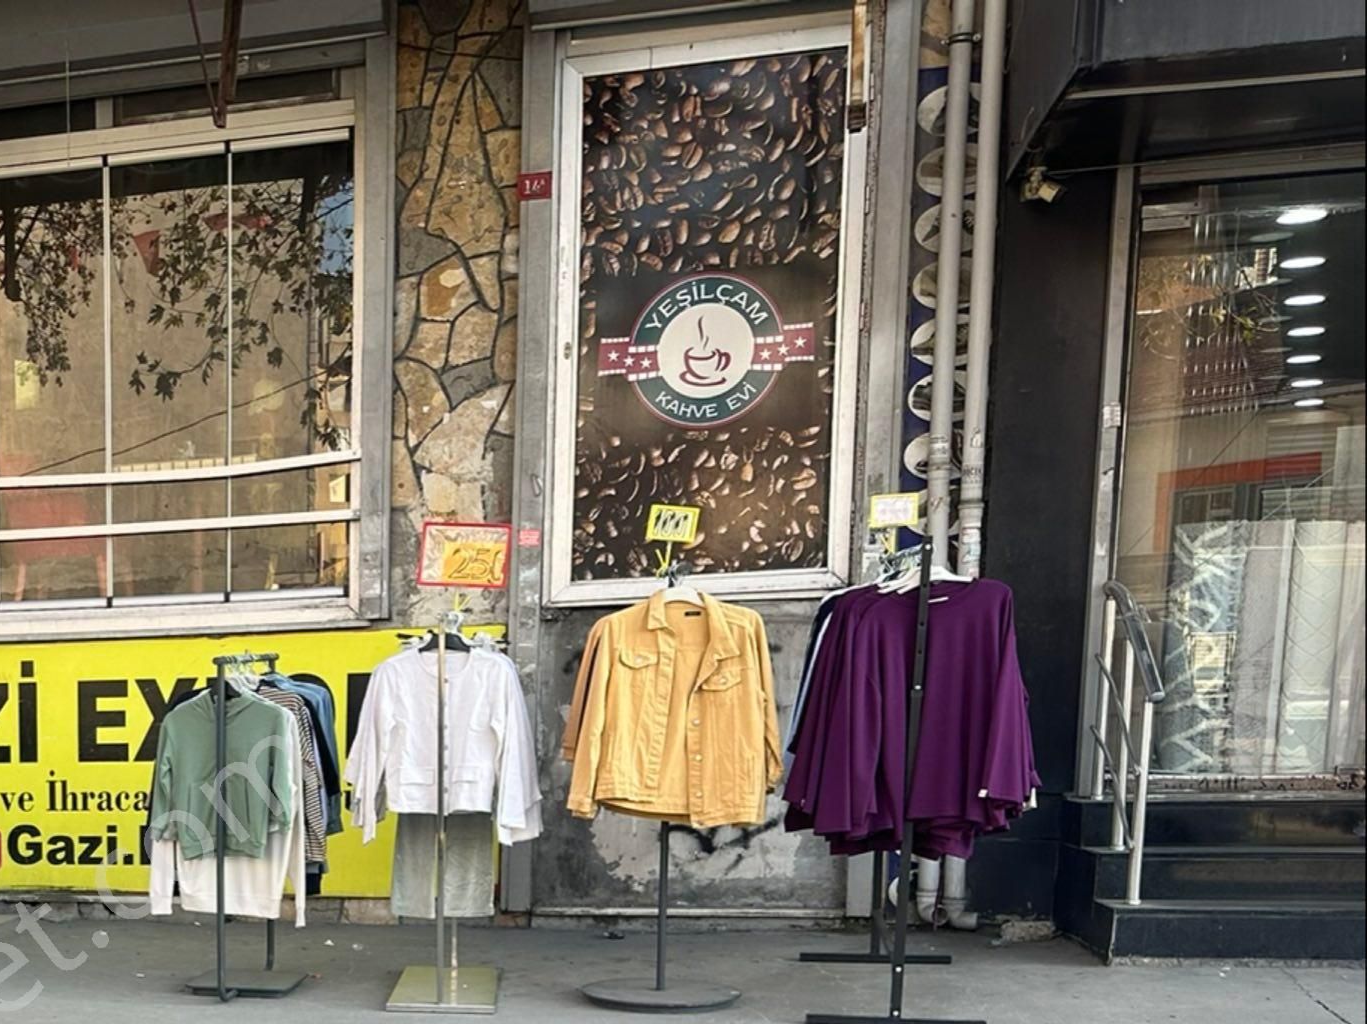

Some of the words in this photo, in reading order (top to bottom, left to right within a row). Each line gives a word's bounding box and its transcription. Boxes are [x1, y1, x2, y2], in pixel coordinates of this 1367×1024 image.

[644, 281, 769, 329] YEŞİLÇAM
[654, 391, 718, 418] KAHVE
[726, 381, 757, 410] EVİ
[0, 790, 34, 813] ve
[45, 769, 150, 813] İhraca
